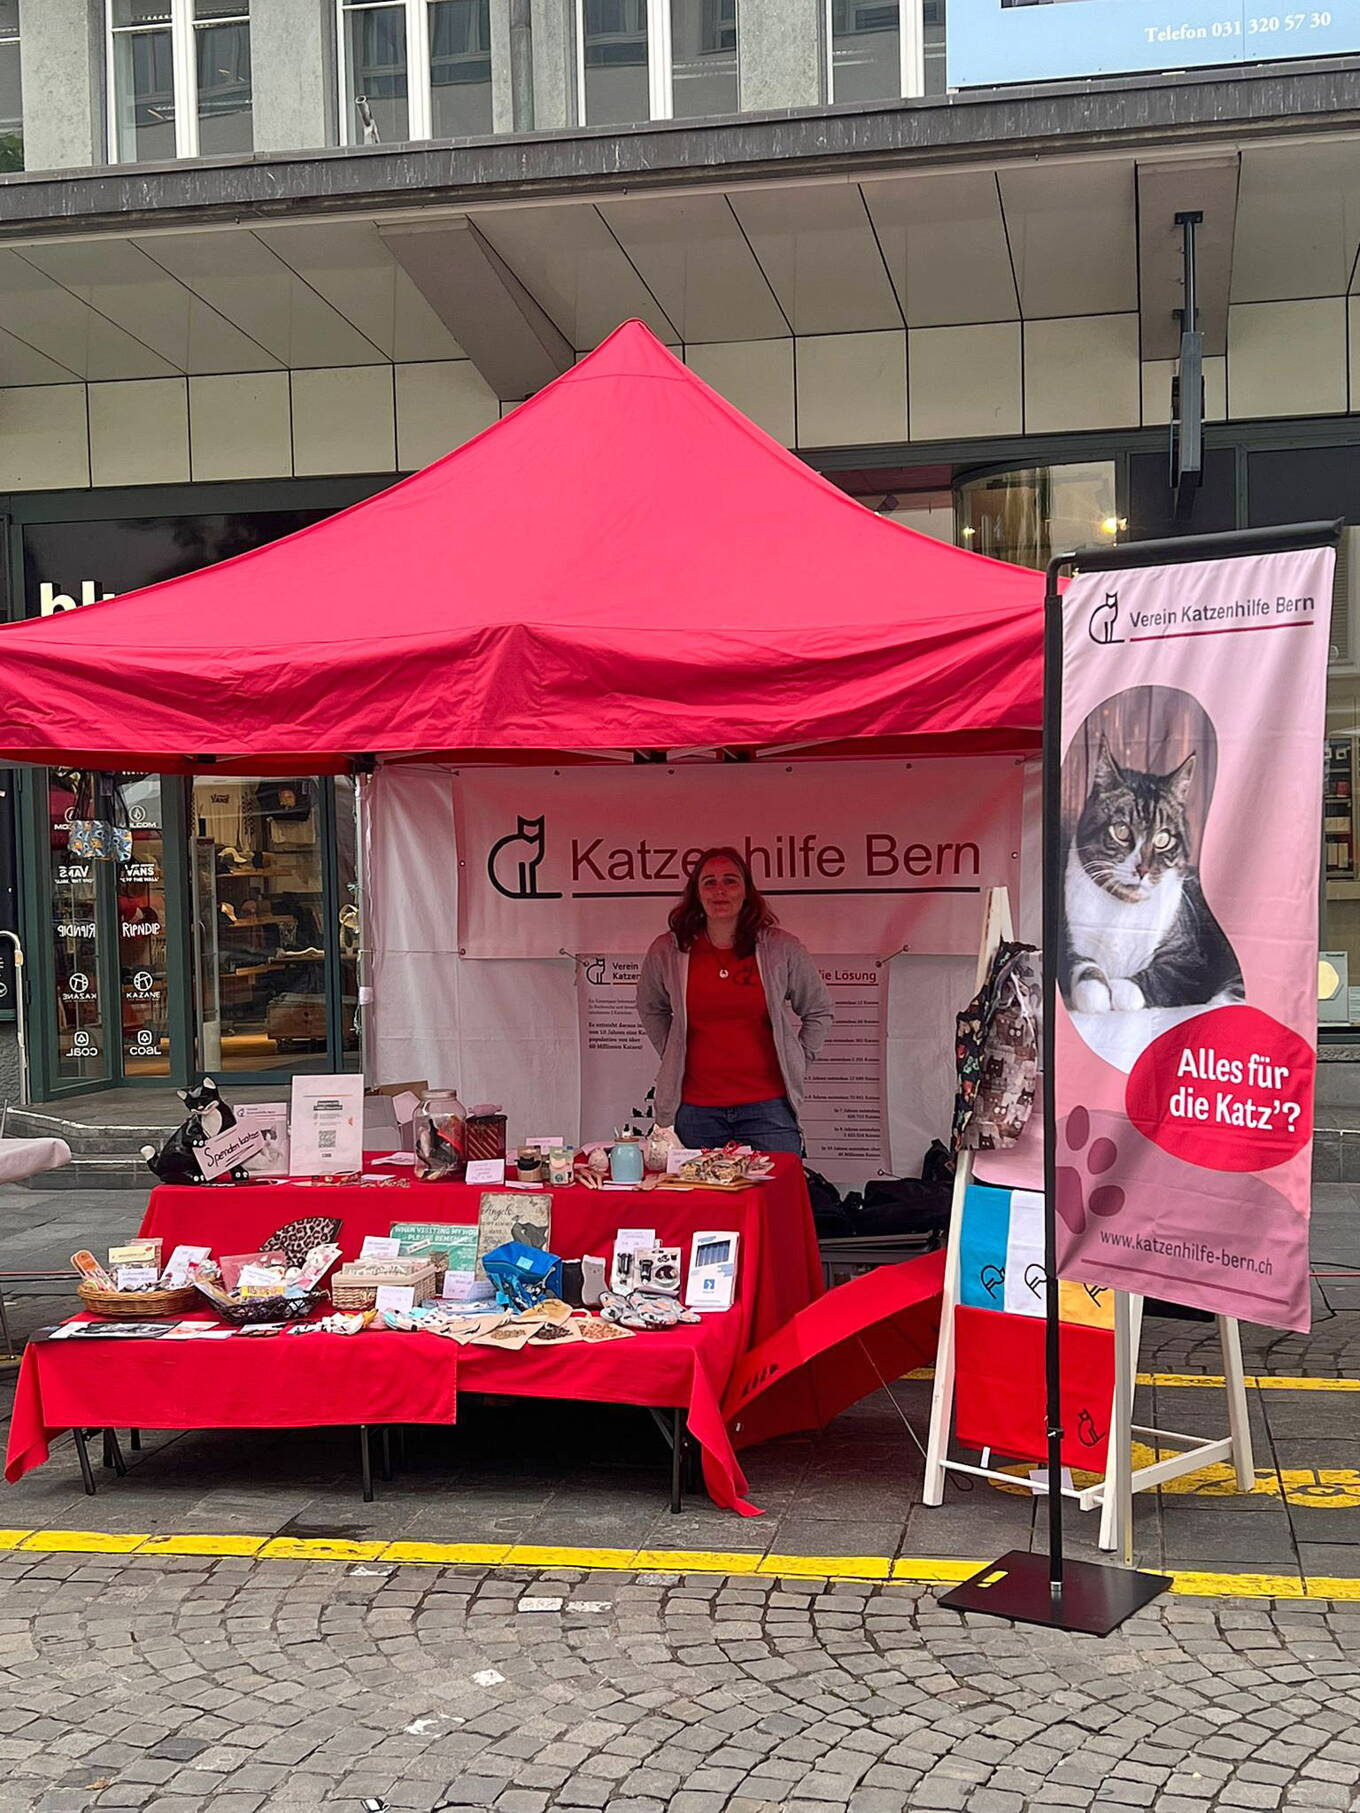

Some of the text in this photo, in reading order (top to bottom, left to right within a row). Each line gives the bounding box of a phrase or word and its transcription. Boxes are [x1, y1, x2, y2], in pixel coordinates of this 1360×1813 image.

[1144, 11, 1331, 42] Telefon 031 320 57 30
[1130, 596, 1314, 628] Verein Katzenhilfe Bern
[125, 864, 155, 877] VANS
[571, 833, 980, 881] Katzehilfe Bern
[122, 922, 160, 938] RIPNDIP
[613, 962, 638, 970] Verein
[819, 970, 877, 983] ie Lösung
[1177, 1048, 1289, 1089] Alles für
[1170, 1087, 1301, 1132] die Katz’?
[1100, 1230, 1273, 1276] www.katzenhilfe-bern.ch
